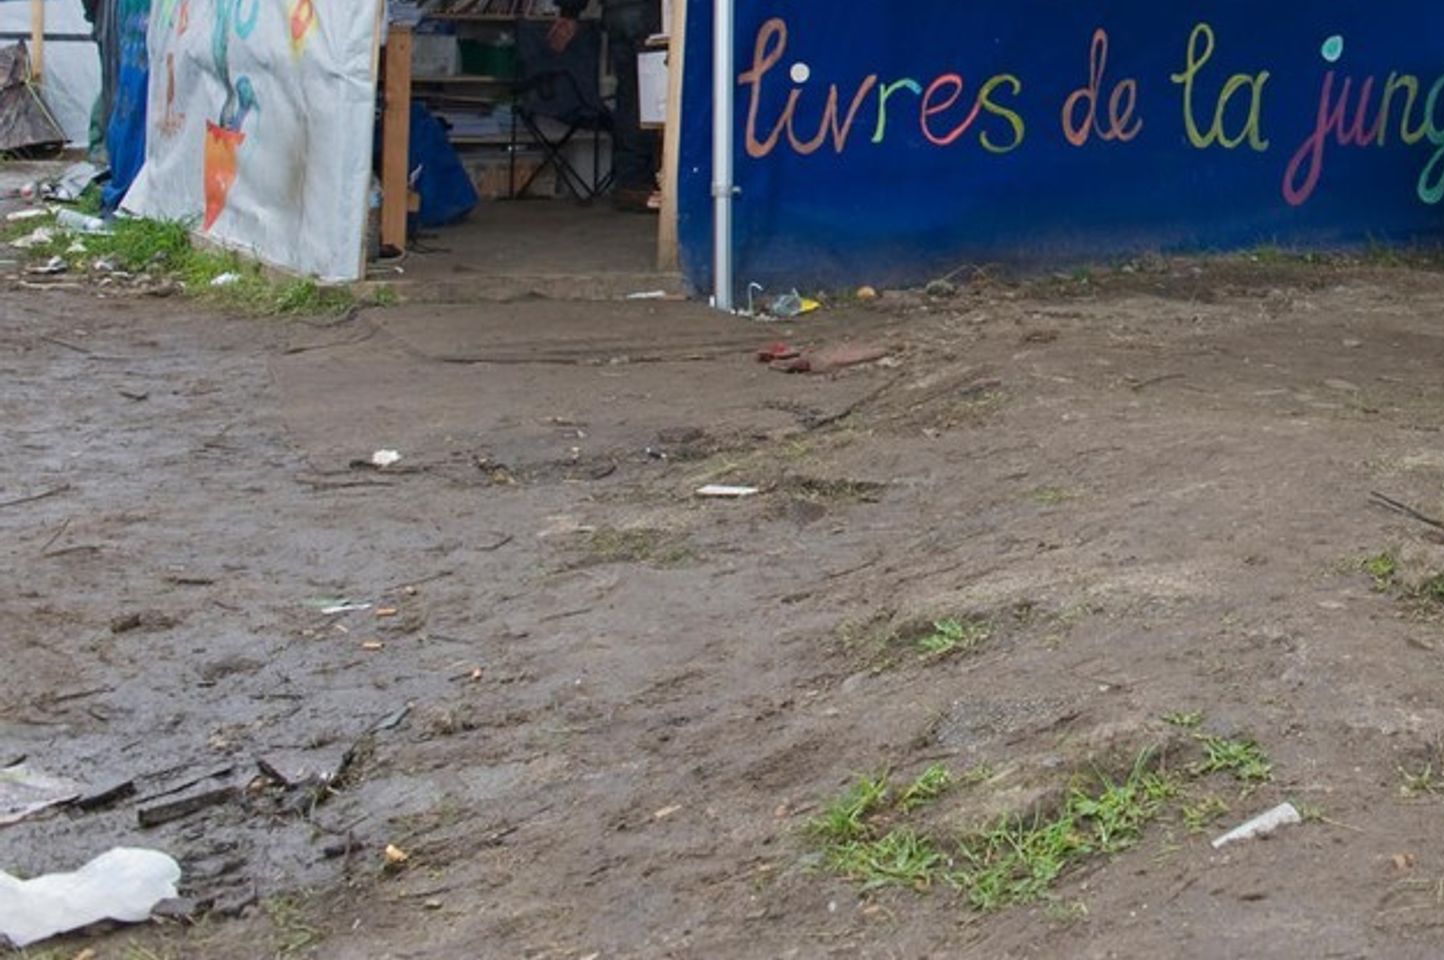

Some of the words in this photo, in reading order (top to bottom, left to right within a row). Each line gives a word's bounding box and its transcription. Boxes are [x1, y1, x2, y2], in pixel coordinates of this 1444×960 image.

[738, 18, 1027, 159] livres
[1062, 28, 1143, 147] de
[1171, 23, 1269, 152] la
